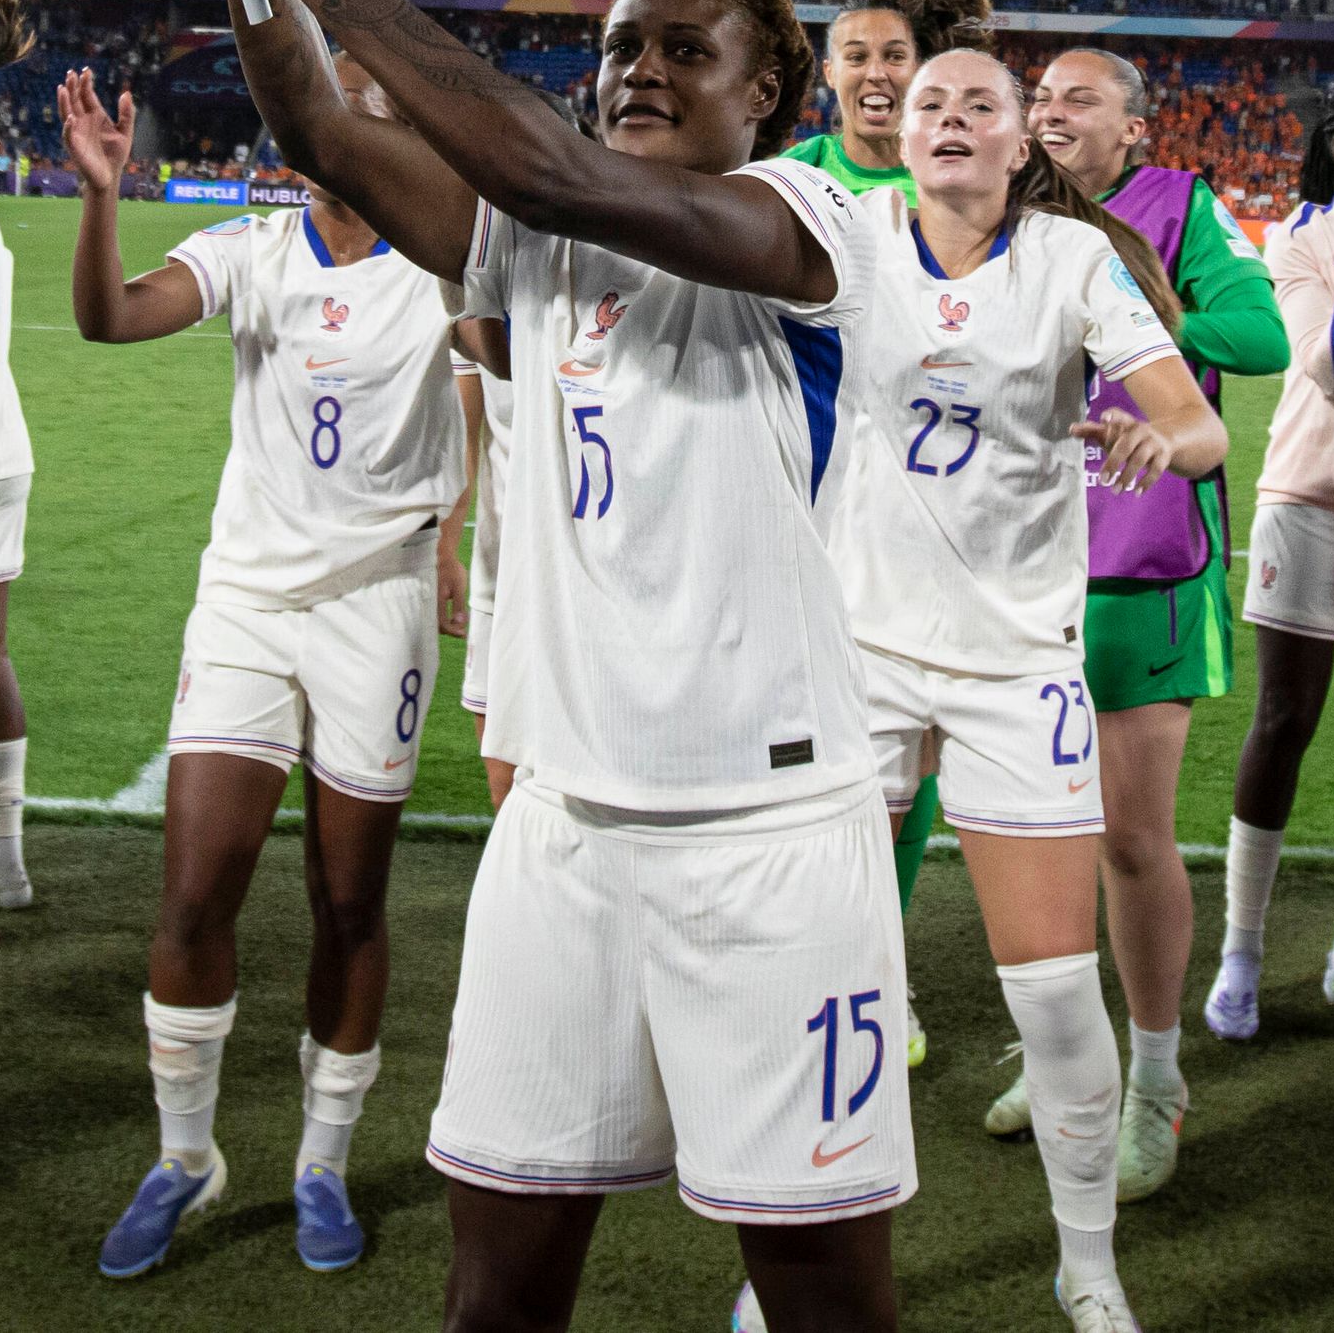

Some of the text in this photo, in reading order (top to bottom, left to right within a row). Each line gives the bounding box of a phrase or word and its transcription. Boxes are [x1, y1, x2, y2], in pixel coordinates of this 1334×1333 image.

[173, 185, 239, 200] RECYCLE
[311, 395, 342, 470] 8
[906, 397, 982, 477] 23
[396, 668, 422, 744] 8
[1040, 680, 1092, 766] 23
[806, 988, 885, 1123] 15
